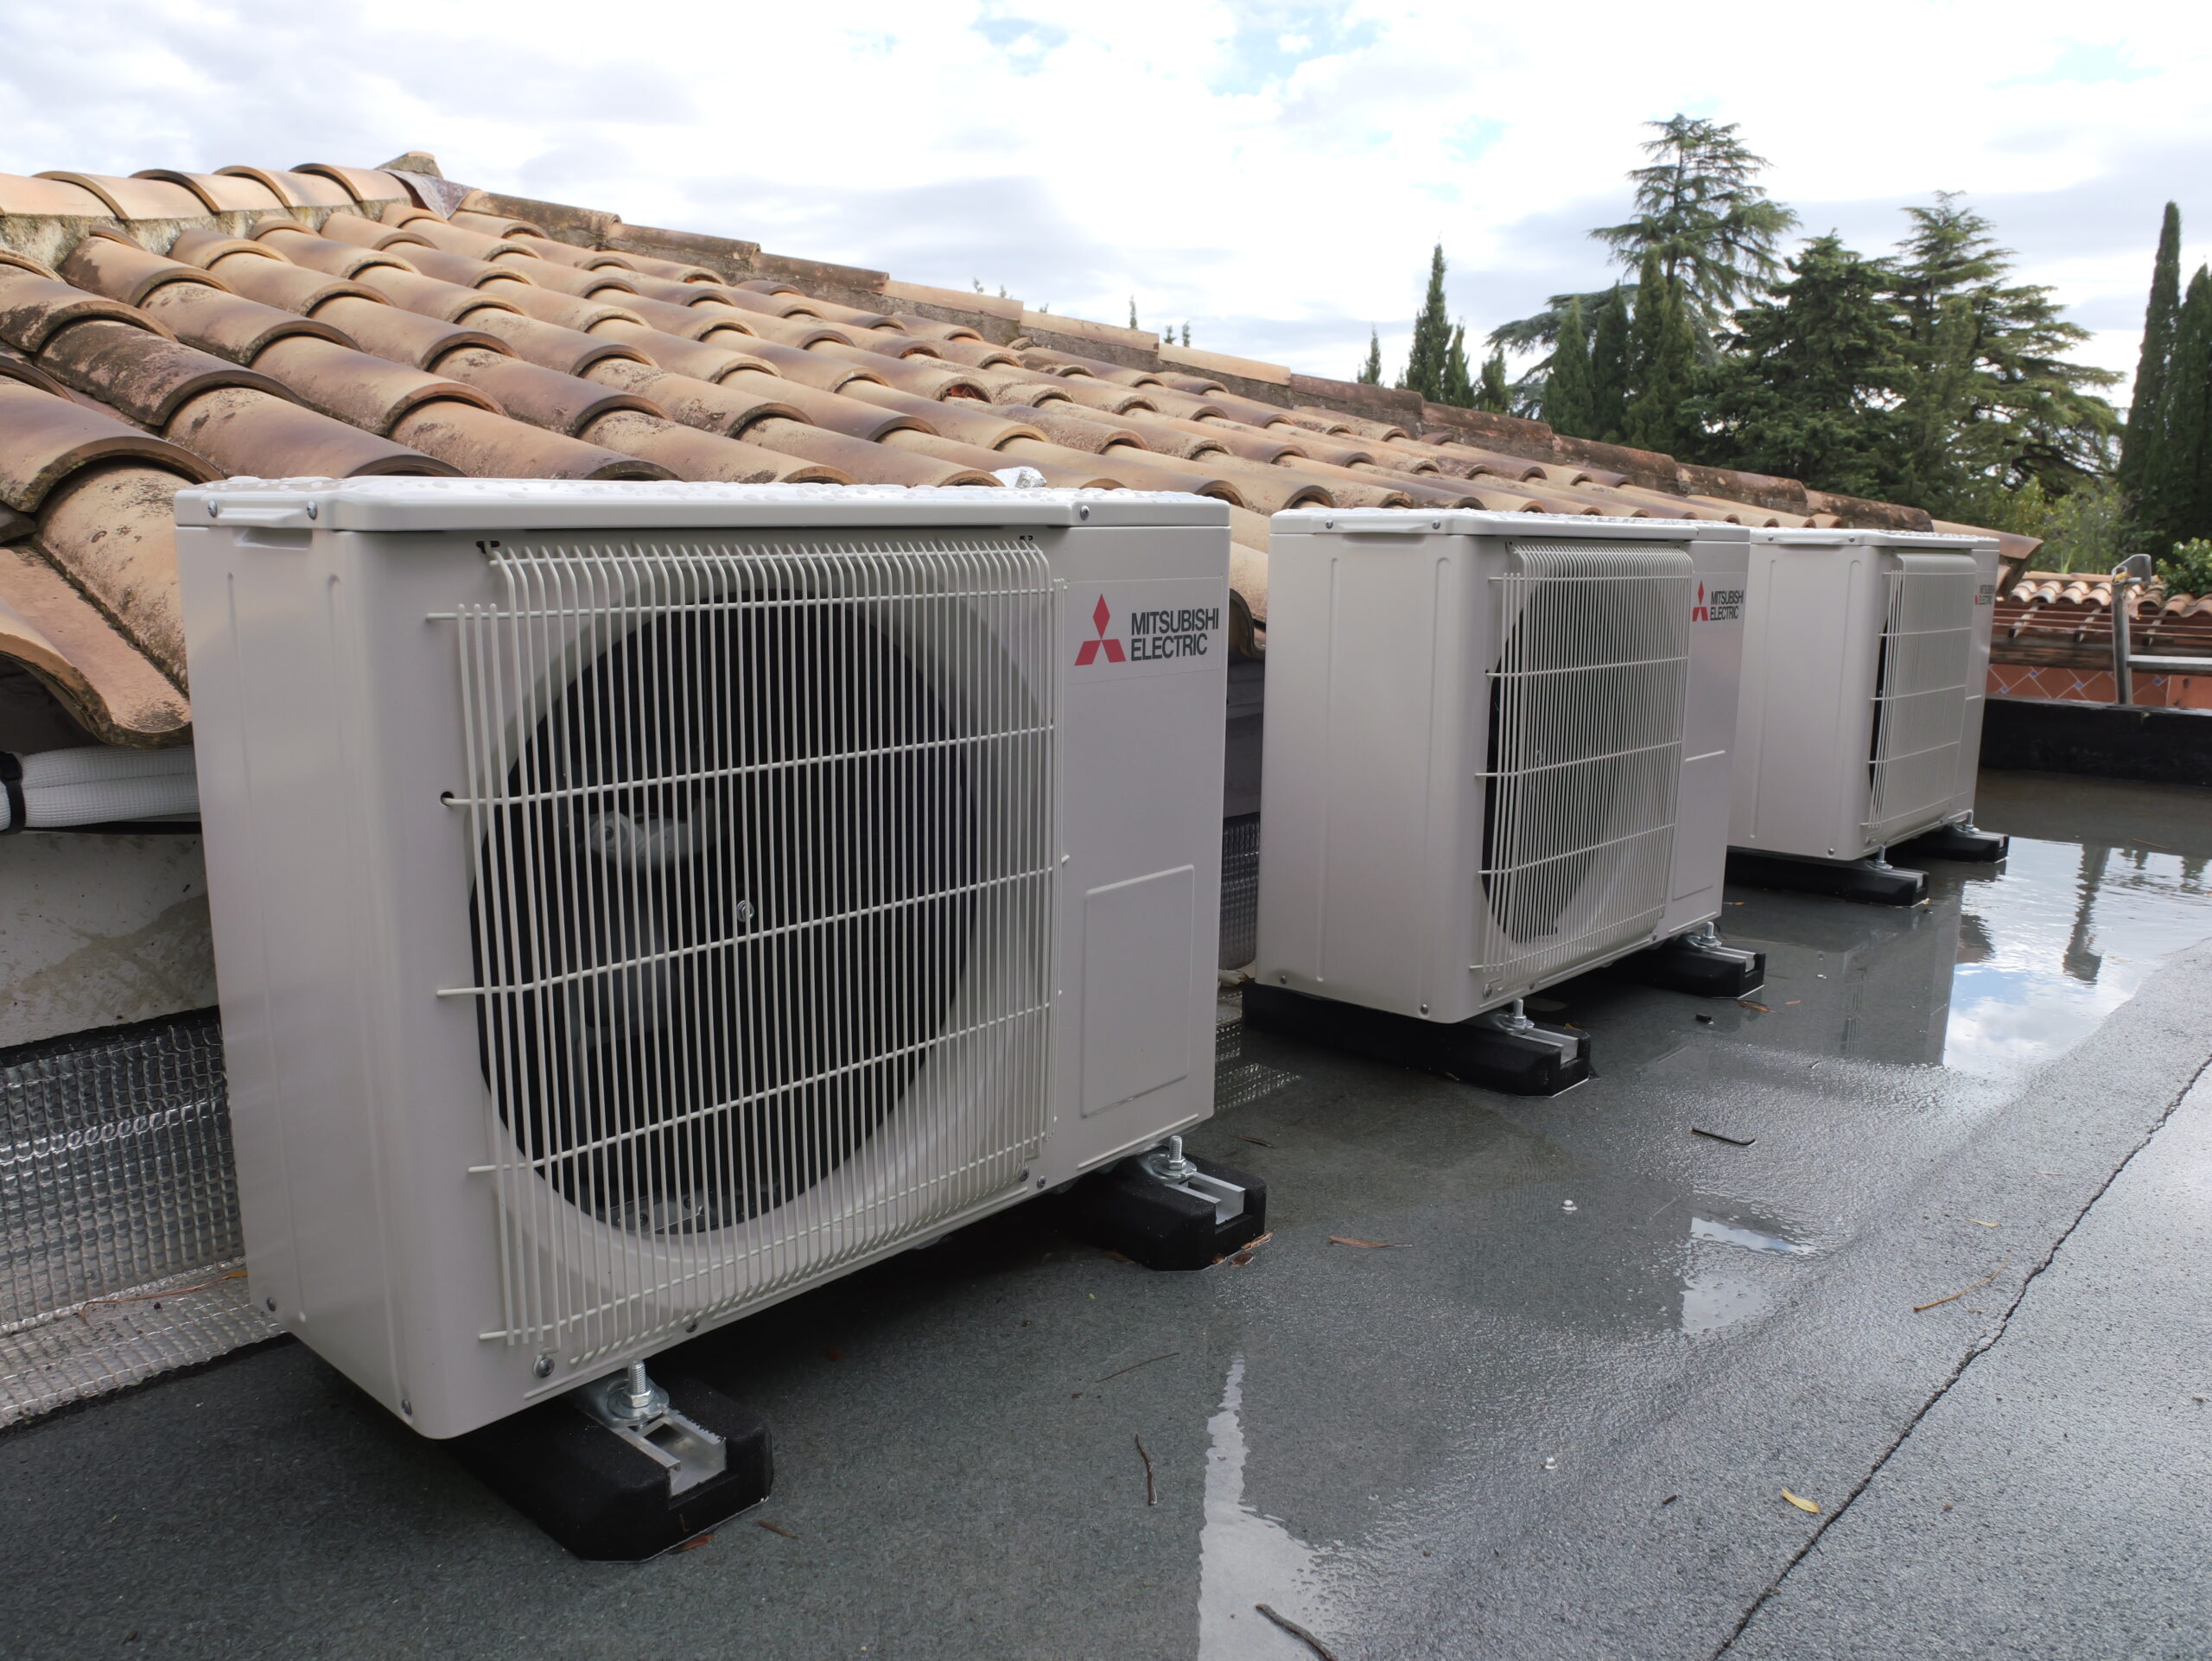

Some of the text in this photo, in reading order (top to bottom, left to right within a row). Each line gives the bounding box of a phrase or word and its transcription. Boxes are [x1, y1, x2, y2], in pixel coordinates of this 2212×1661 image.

[1131, 608, 1219, 636] MITSUBISHI
[1710, 605, 1739, 621] ELECTRIC
[1130, 633, 1208, 662] ELECTRIC
